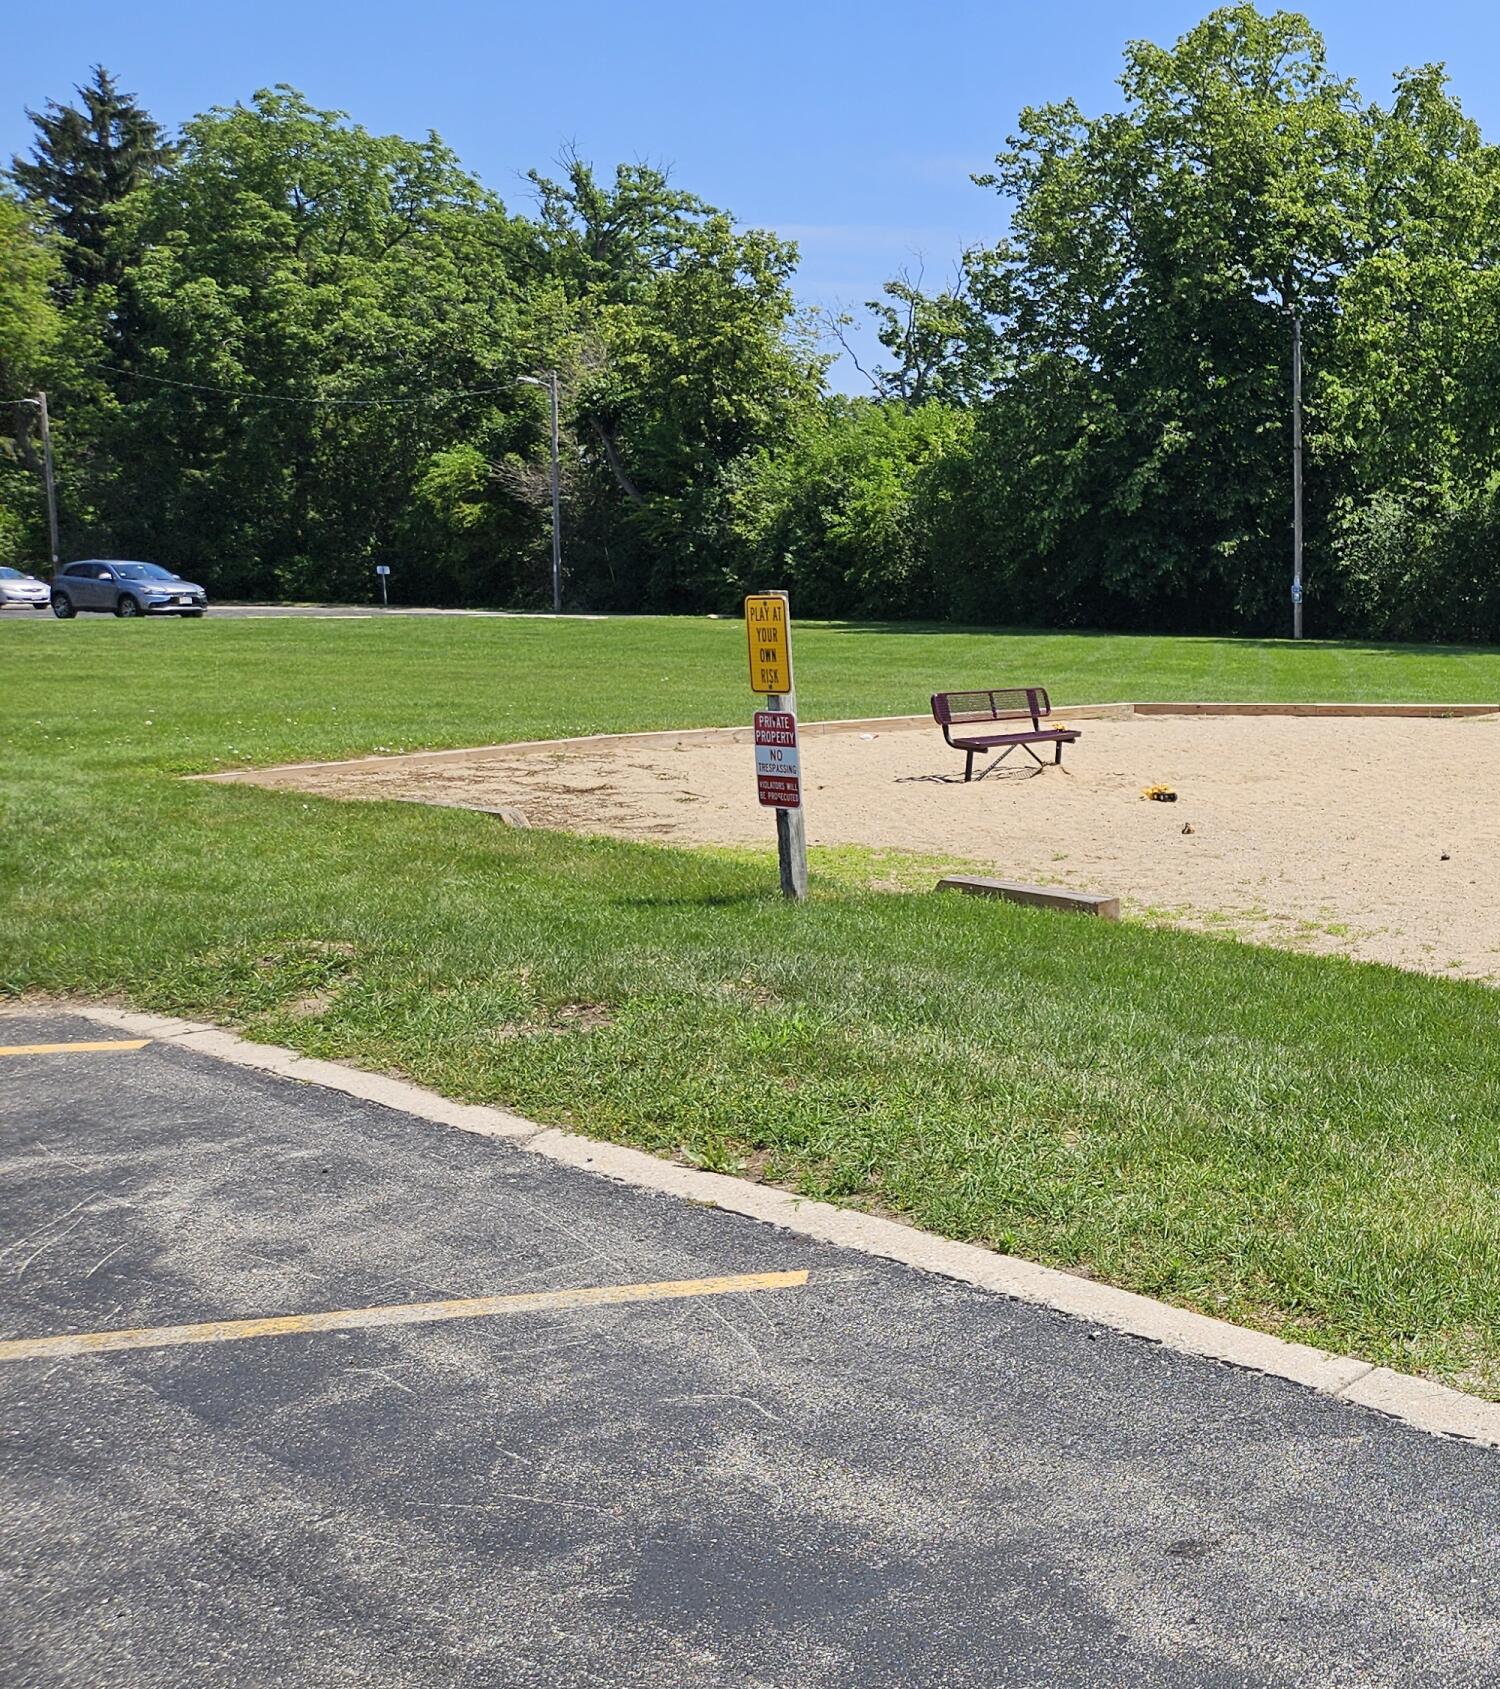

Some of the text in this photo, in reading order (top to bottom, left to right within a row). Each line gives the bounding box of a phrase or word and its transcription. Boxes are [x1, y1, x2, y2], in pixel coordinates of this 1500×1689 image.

[750, 607, 781, 621] PLAY AT
[756, 627, 778, 642] YOUR
[760, 648, 777, 662] OWN
[761, 669, 779, 684] RISK
[759, 716, 789, 729] PRIVATE
[756, 730, 794, 744] PROPERTY
[770, 749, 783, 761] NO
[758, 762, 797, 774] TRESPASSING
[760, 781, 798, 791] VIOLATORS WILL
[760, 791, 798, 802] BE PROSECUTED
